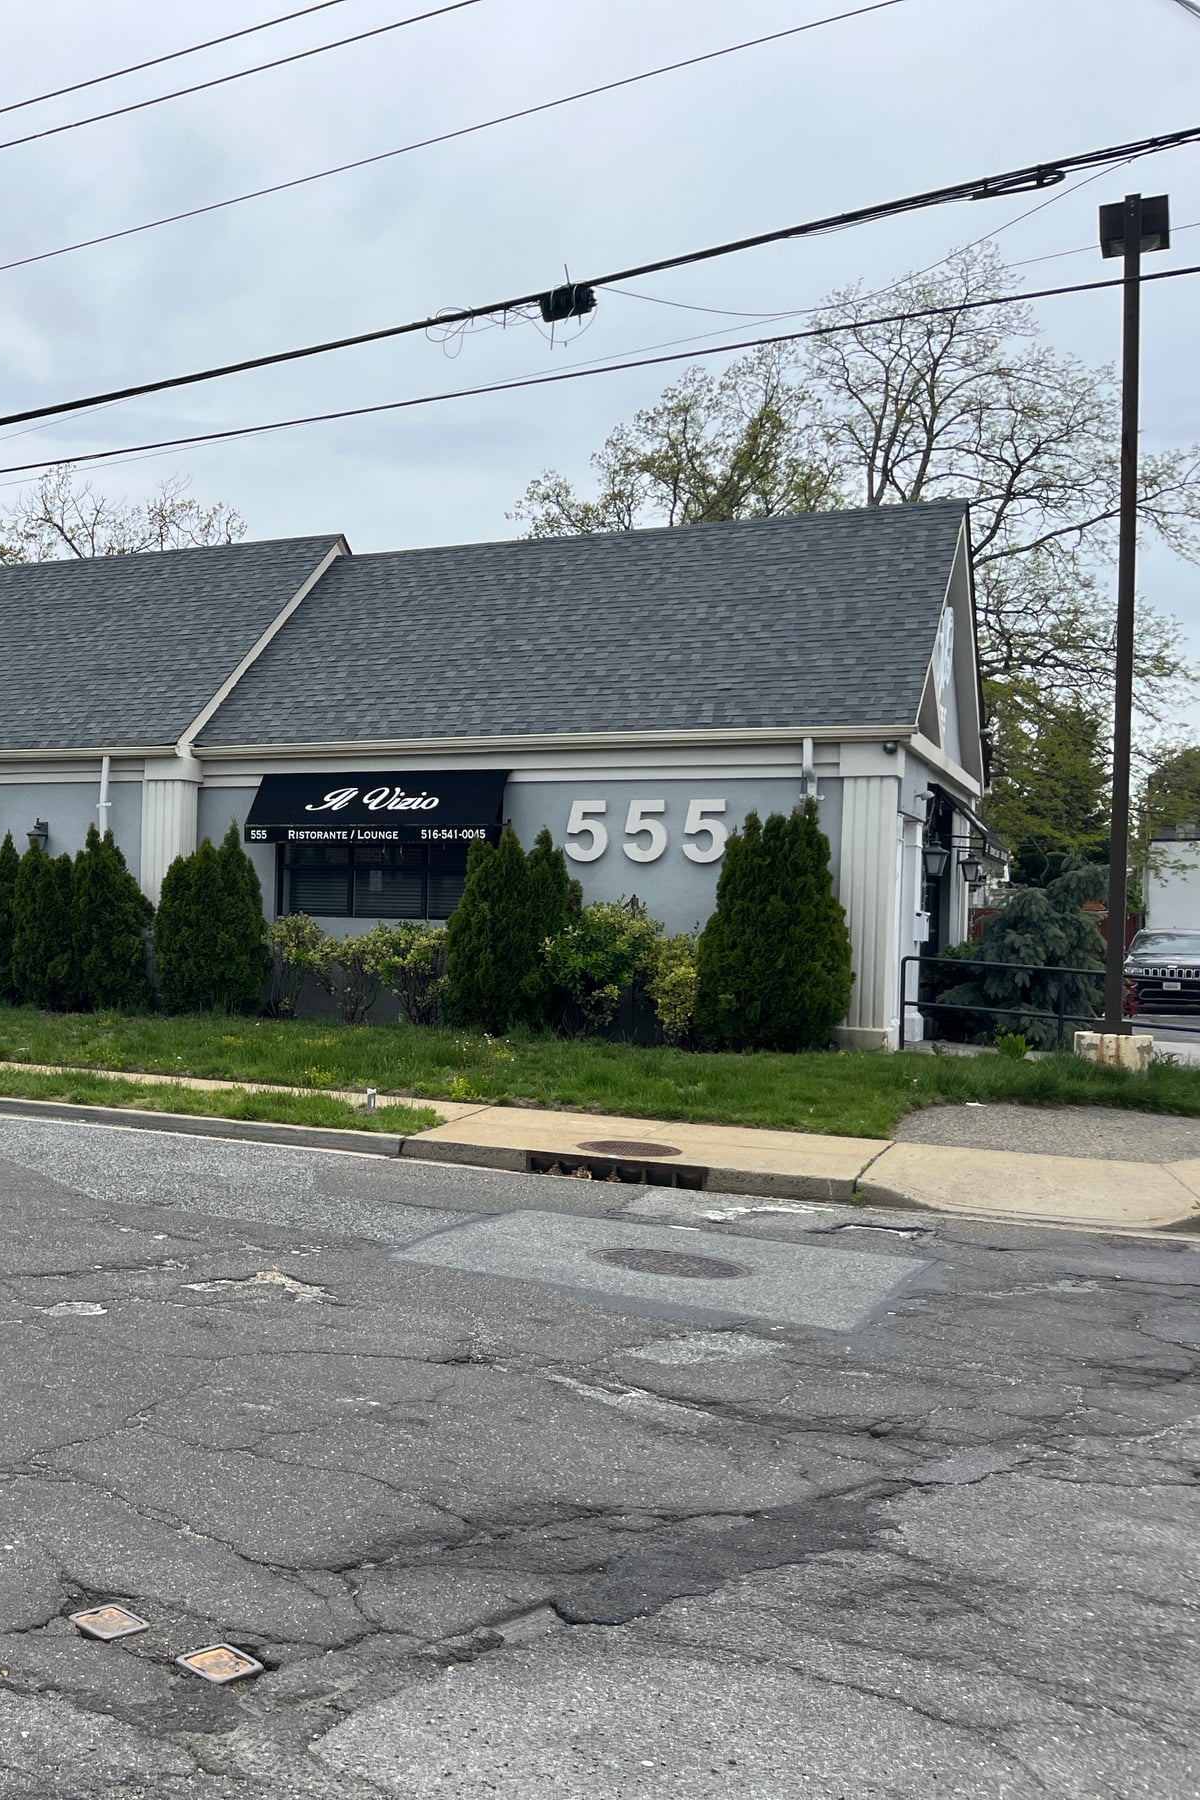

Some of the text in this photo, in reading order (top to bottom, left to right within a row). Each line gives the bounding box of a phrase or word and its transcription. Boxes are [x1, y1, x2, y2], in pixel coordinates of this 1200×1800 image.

[305, 787, 440, 811] Il Vizio
[250, 829, 267, 840] 555
[288, 829, 348, 840] RISTORANTE
[357, 829, 399, 840] LOUNGE
[420, 829, 486, 840] 516-541-0045
[564, 799, 729, 864] 555
